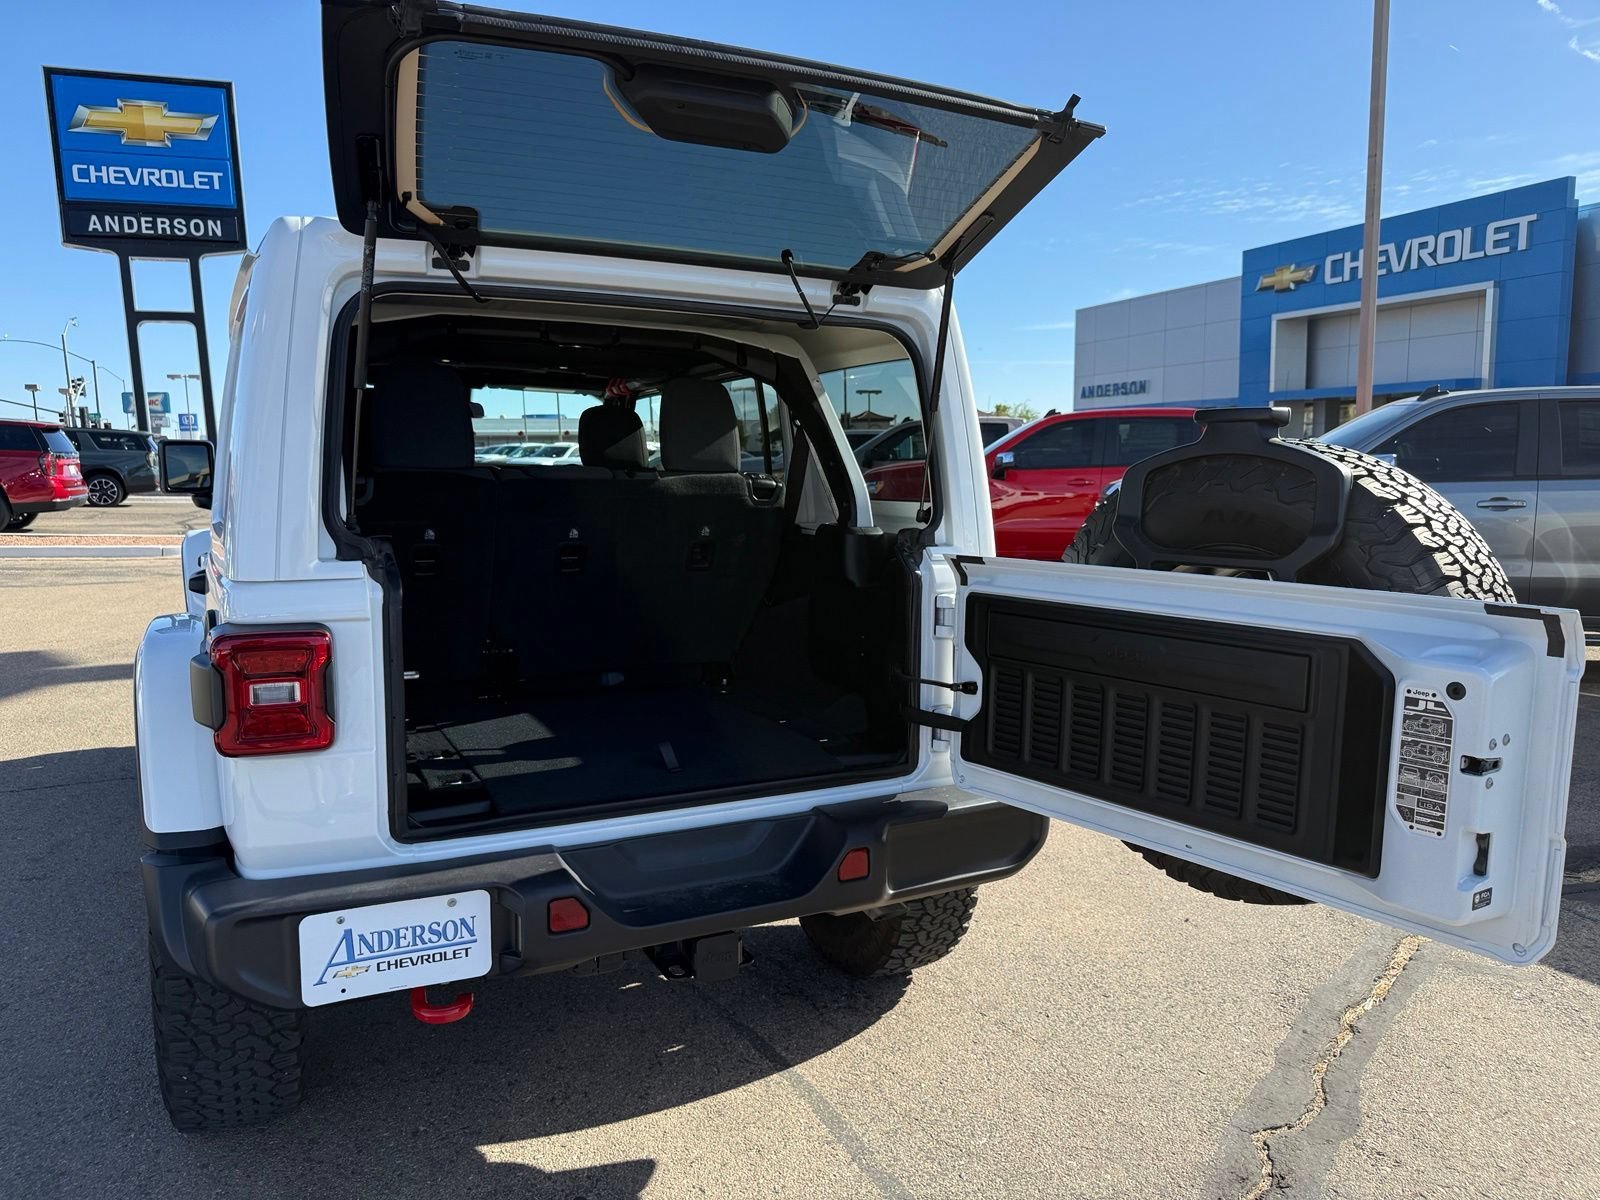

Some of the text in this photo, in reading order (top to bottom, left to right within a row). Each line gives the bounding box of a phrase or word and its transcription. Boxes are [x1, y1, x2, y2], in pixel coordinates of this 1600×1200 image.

[72, 164, 223, 190] CHEVROLET
[88, 214, 222, 237] ANDERSON
[1324, 213, 1538, 285] CHEVROLET
[1080, 380, 1148, 399] ANDERSON
[1412, 689, 1430, 697] Jeep
[313, 915, 478, 987] ANDERSON
[376, 946, 473, 972] CHEVROLET
